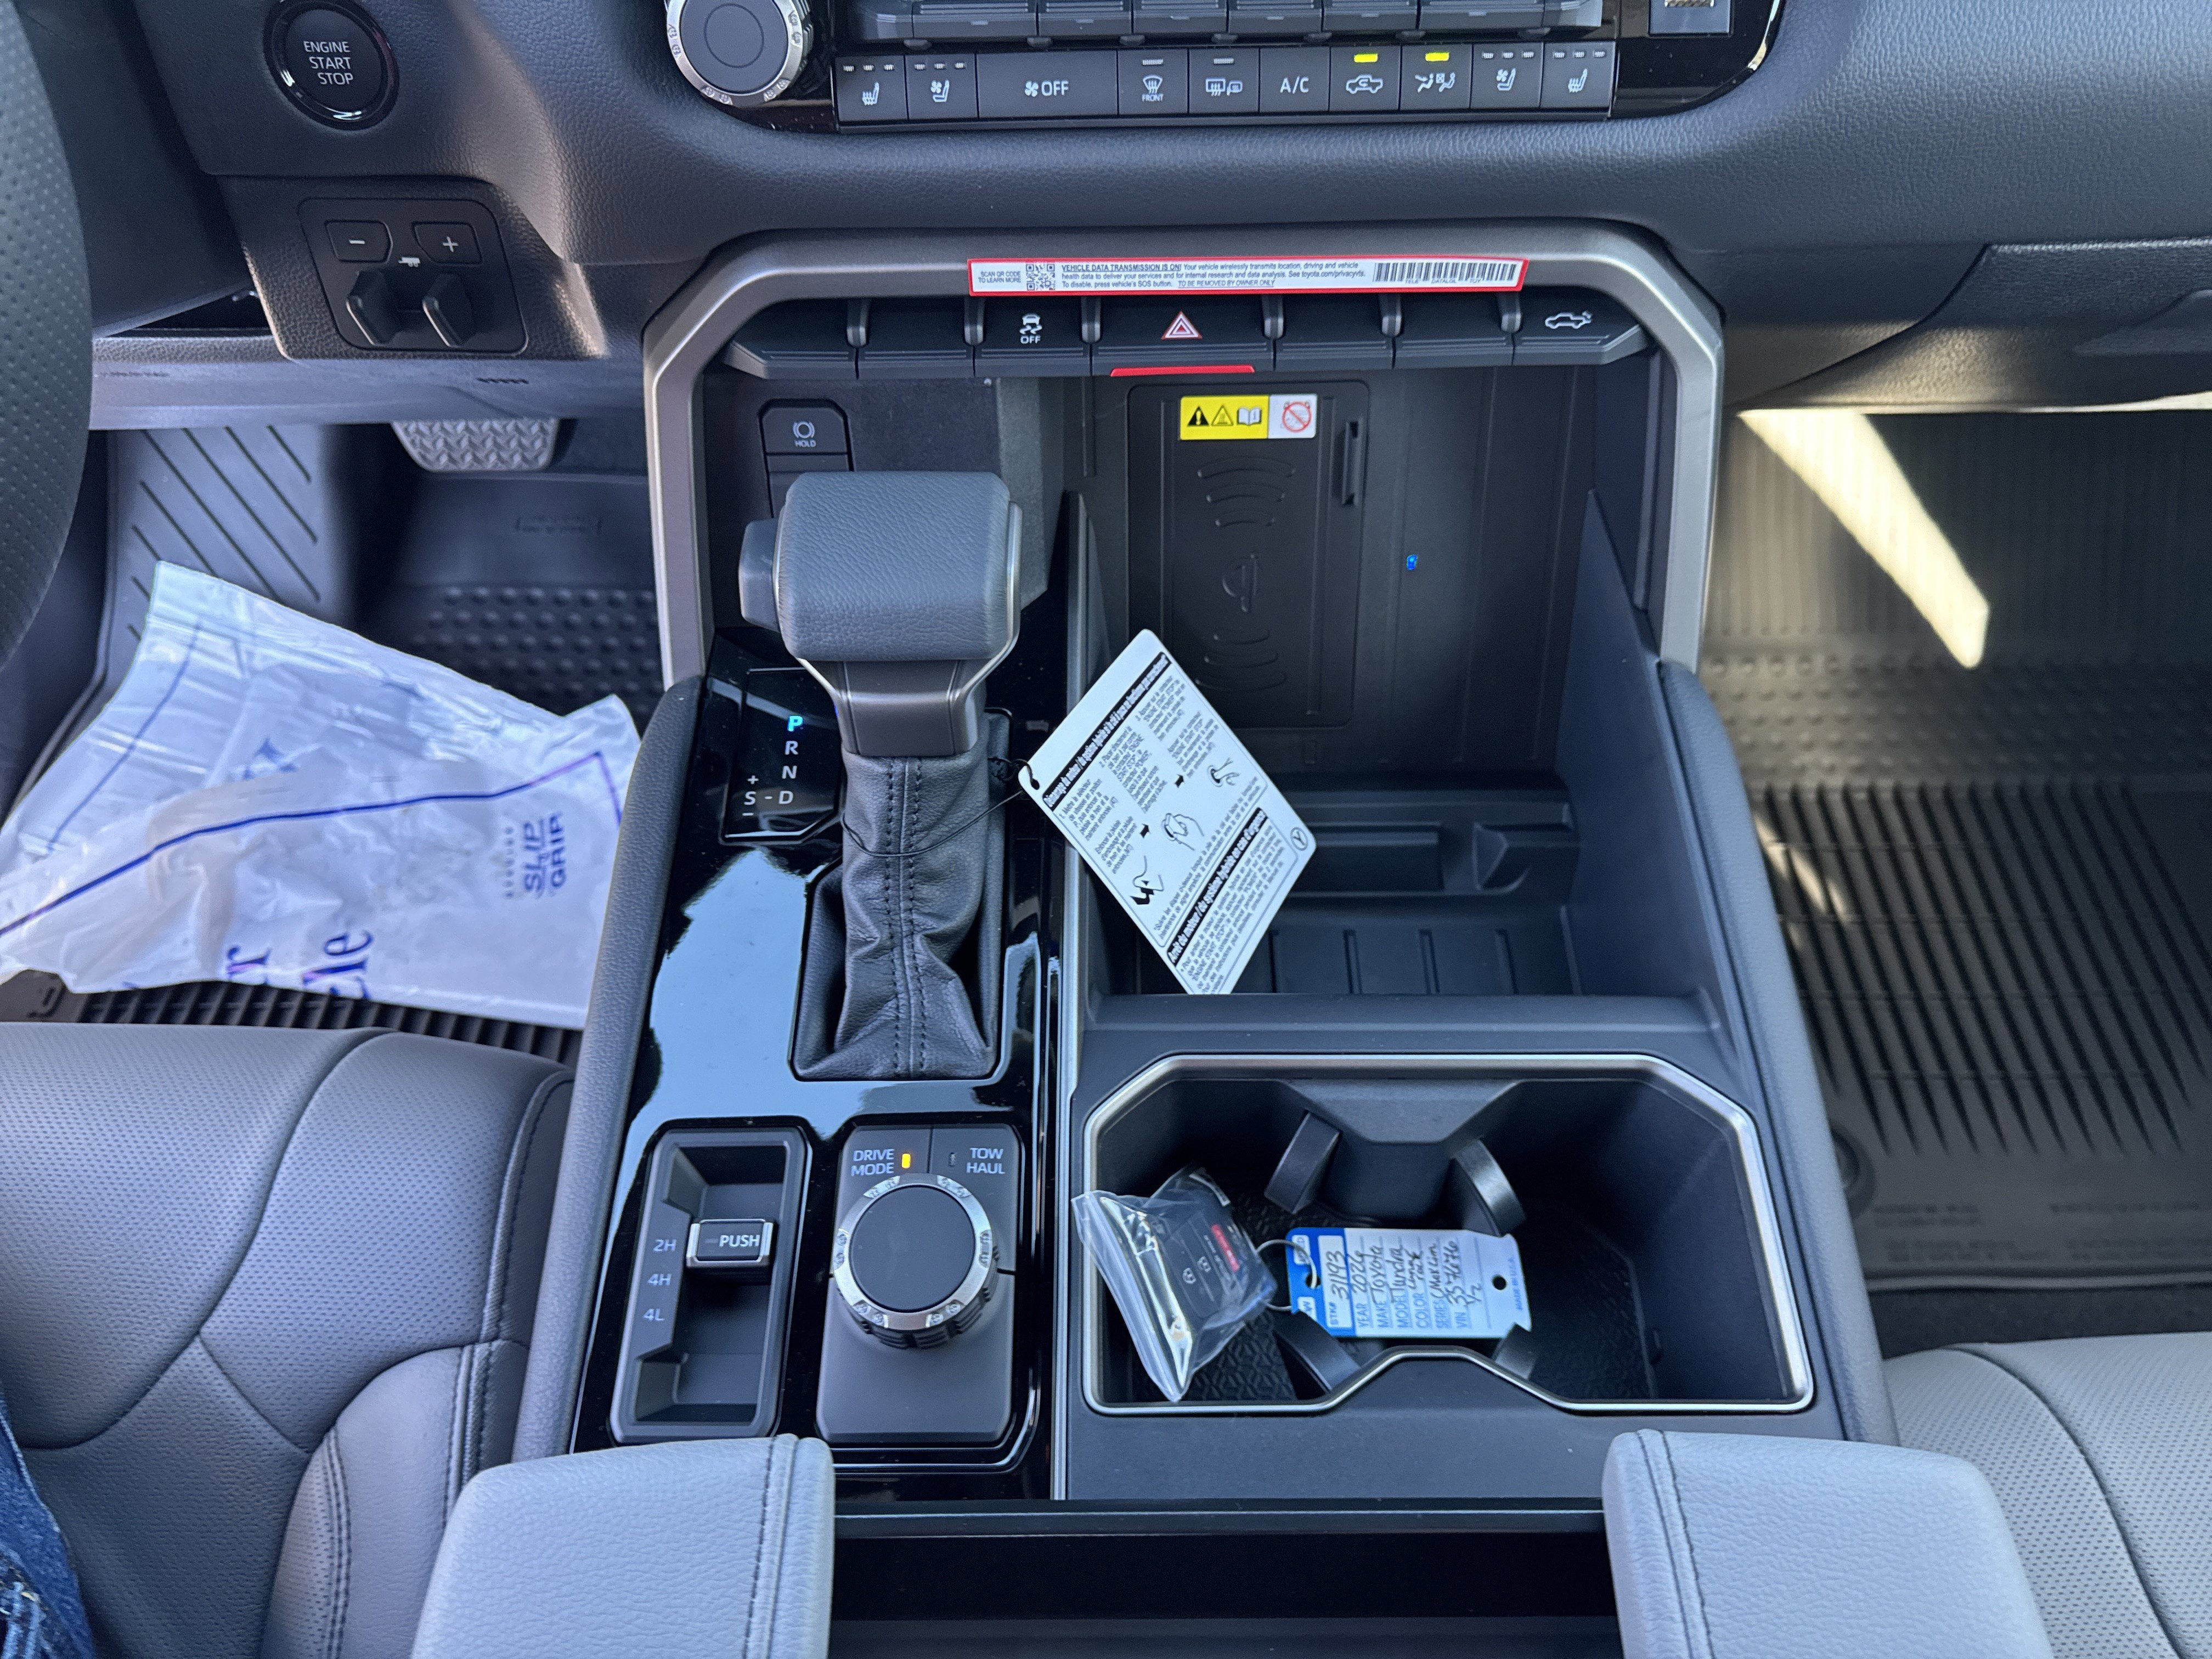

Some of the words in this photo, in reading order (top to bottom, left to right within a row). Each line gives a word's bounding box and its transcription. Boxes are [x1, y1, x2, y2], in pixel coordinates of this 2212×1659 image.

[303, 41, 351, 53] ENGINE
[309, 57, 351, 69] START
[317, 72, 354, 86] STOP
[1280, 76, 1310, 94] A/C
[1041, 80, 1069, 97] OFF
[1142, 94, 1163, 102] FRONT
[1020, 335, 1041, 344] OFF
[794, 439, 816, 448] HOLD
[787, 715, 804, 732] P
[785, 740, 799, 755] R
[782, 765, 797, 780] N
[744, 791, 757, 805] S
[778, 790, 793, 805] D
[852, 1149, 895, 1162] DRIVE
[969, 1148, 1004, 1160] TOW
[850, 1163, 895, 1177] MODE
[966, 1162, 1005, 1175] HAUL
[653, 1239, 676, 1251] 2H
[719, 1234, 760, 1248] PUSH
[647, 1273, 671, 1286] 4H
[1325, 1250, 1349, 1300] 31193
[1370, 1245, 1386, 1305] Toyota
[644, 1308, 665, 1322] 4L
[1329, 1302, 1339, 1325] STK#
[1355, 1302, 1369, 1328] YEAR
[1375, 1300, 1389, 1328] MAKE
[1395, 1290, 1408, 1328] MODEL
[1413, 1292, 1427, 1329] COLOR
[1433, 1299, 1452, 1329] SERIES
[1454, 1312, 1468, 1329] VIN
